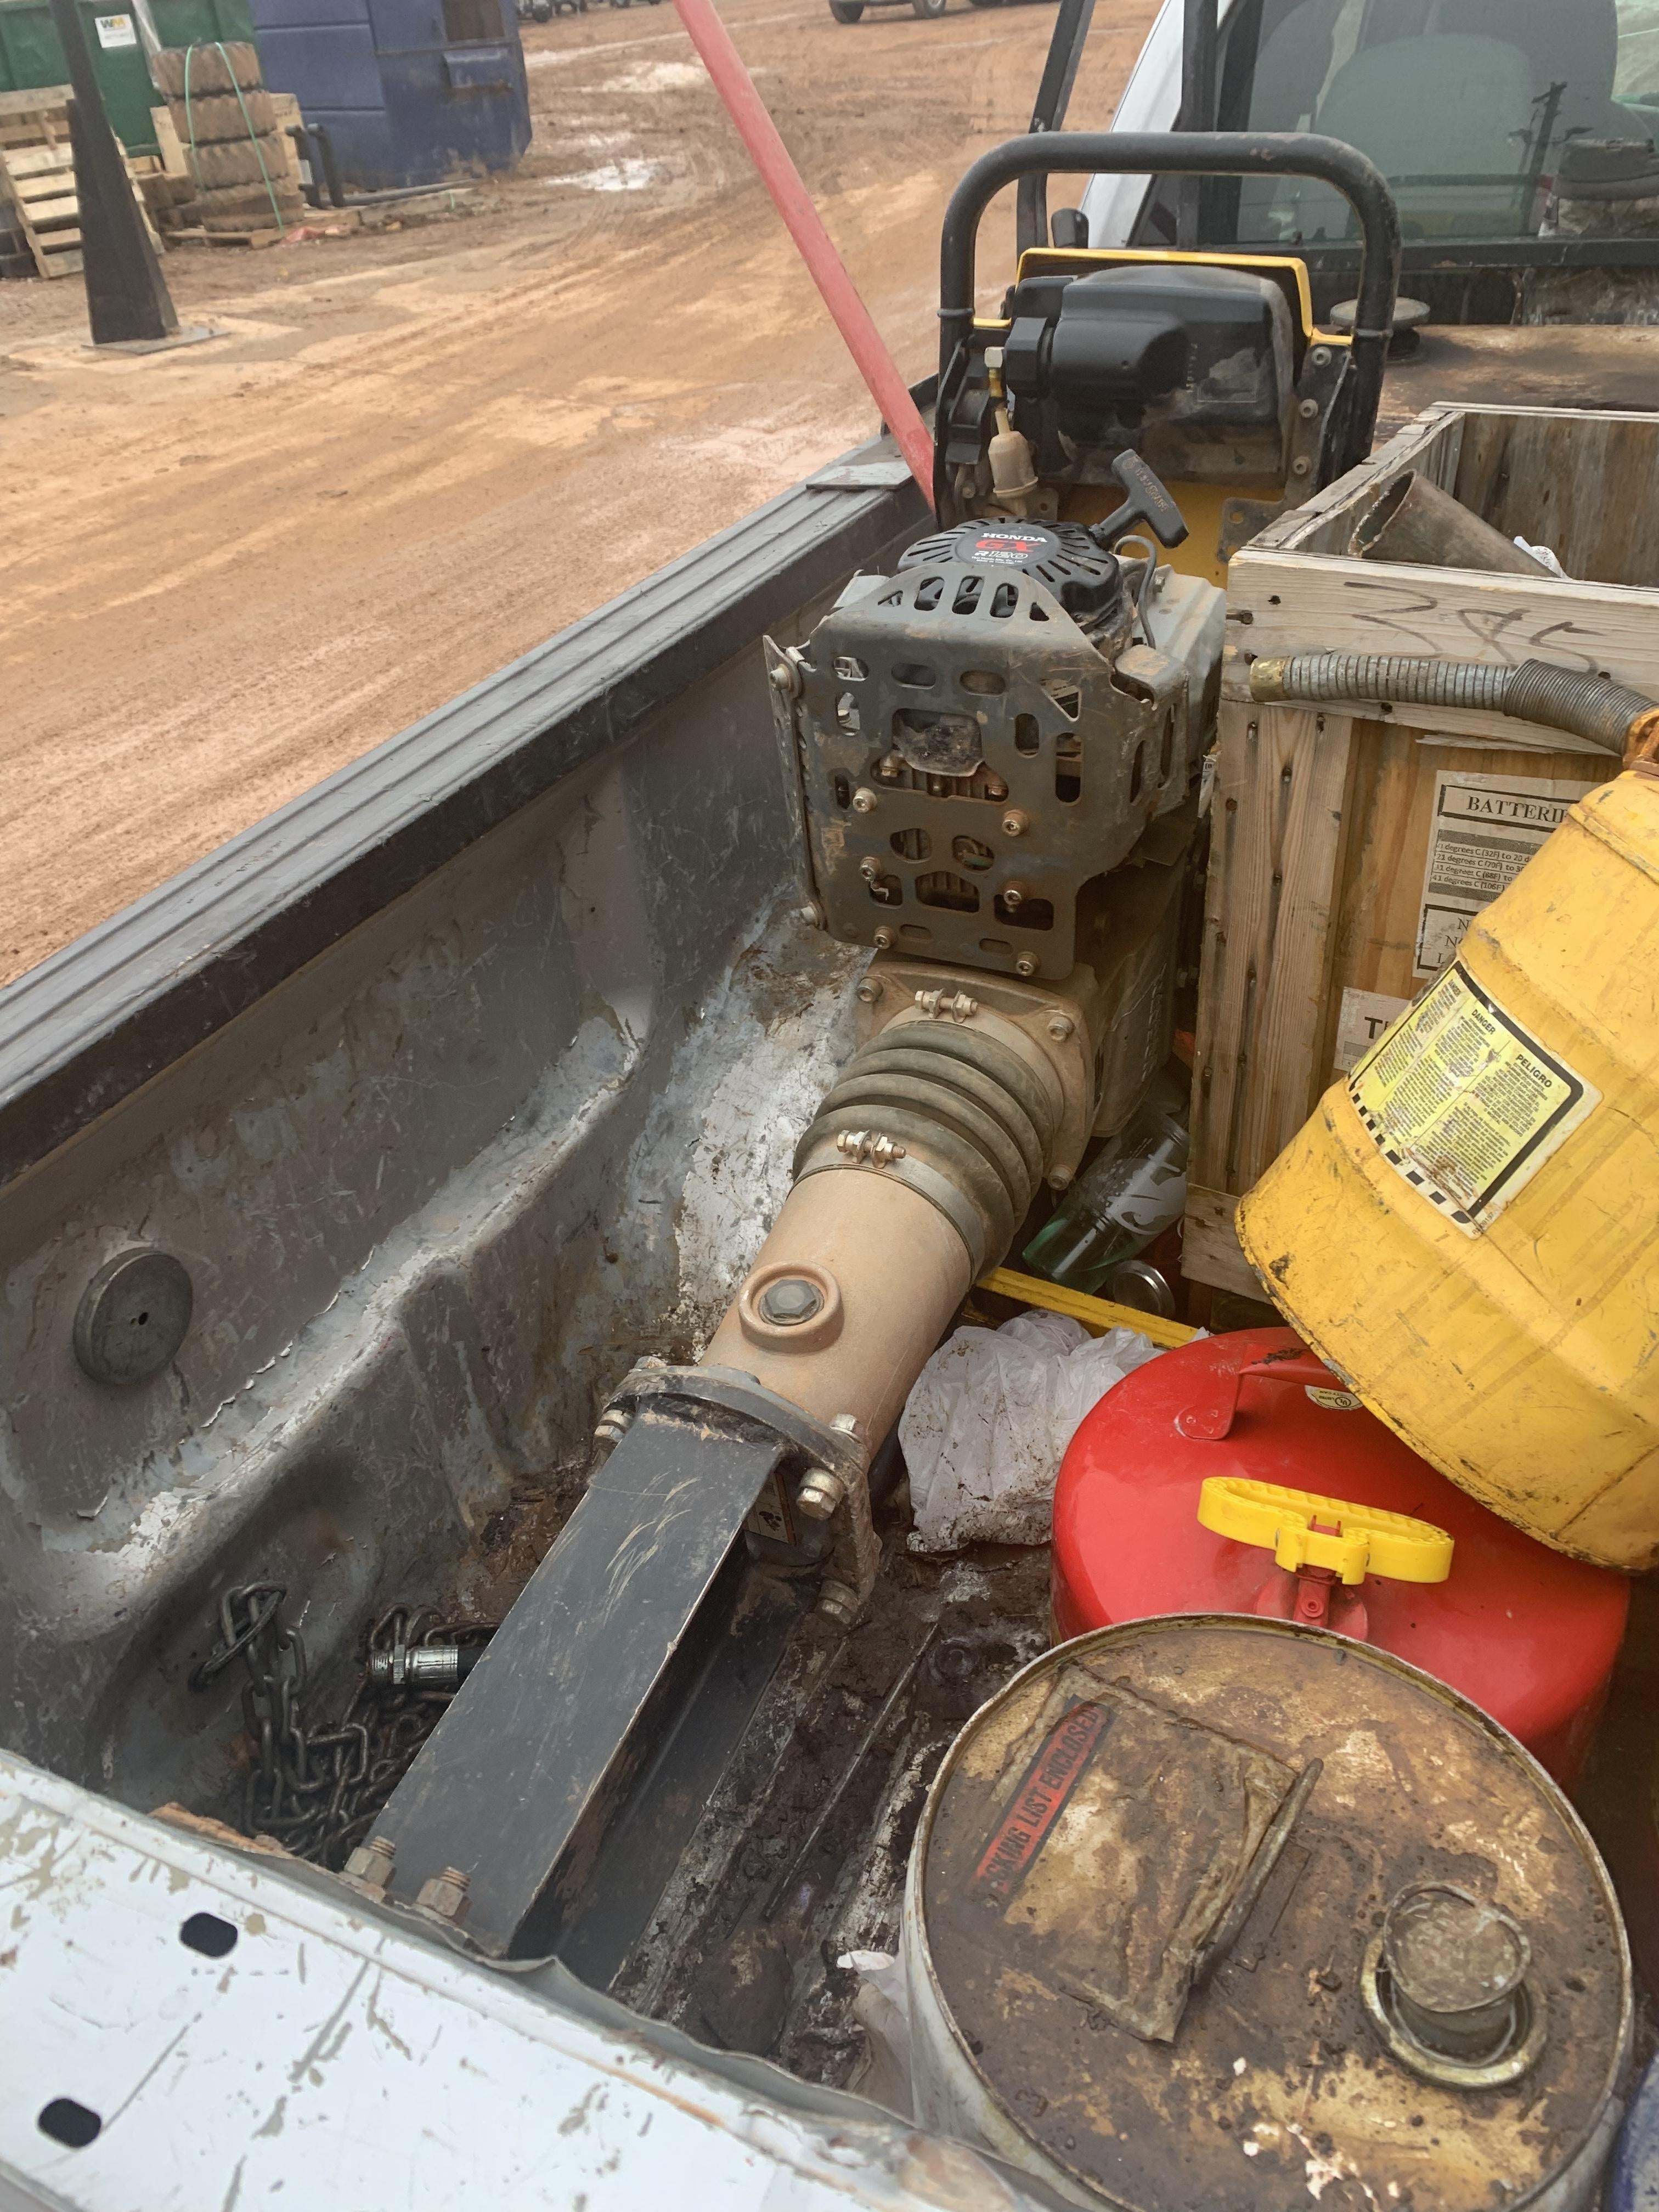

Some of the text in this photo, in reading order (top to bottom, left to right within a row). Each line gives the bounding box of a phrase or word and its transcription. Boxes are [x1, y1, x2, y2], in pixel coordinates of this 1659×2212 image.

[981, 532, 1047, 543] HONDA
[1444, 843, 1474, 855] degrees
[1447, 854, 1476, 866] degrees
[1445, 865, 1474, 877] degrees
[1443, 875, 1472, 887] degrees
[1471, 1009, 1496, 1035] DANGER
[1516, 1053, 1552, 1088] PELIGRO
[1017, 1788, 1052, 1827] LIST
[1040, 1709, 1100, 1790] ENCLOSED
